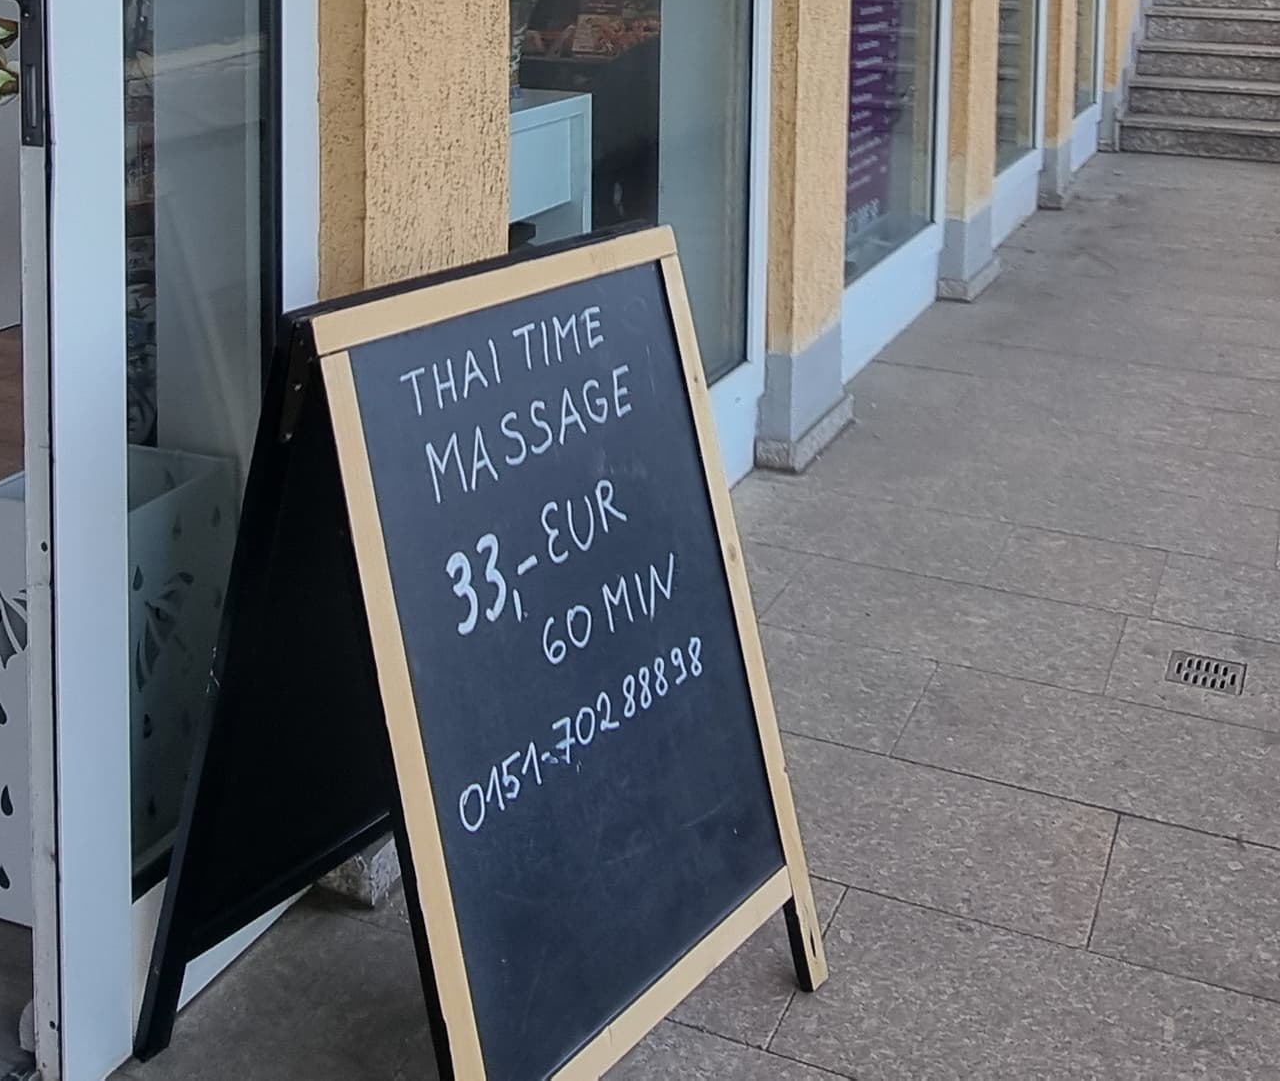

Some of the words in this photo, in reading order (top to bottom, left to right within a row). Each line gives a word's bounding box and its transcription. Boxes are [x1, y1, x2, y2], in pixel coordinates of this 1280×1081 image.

[399, 338, 501, 416] THAI
[512, 306, 604, 370] TIME
[425, 364, 632, 504] MASSAGE
[542, 604, 592, 665] 60
[601, 552, 675, 633] MIN
